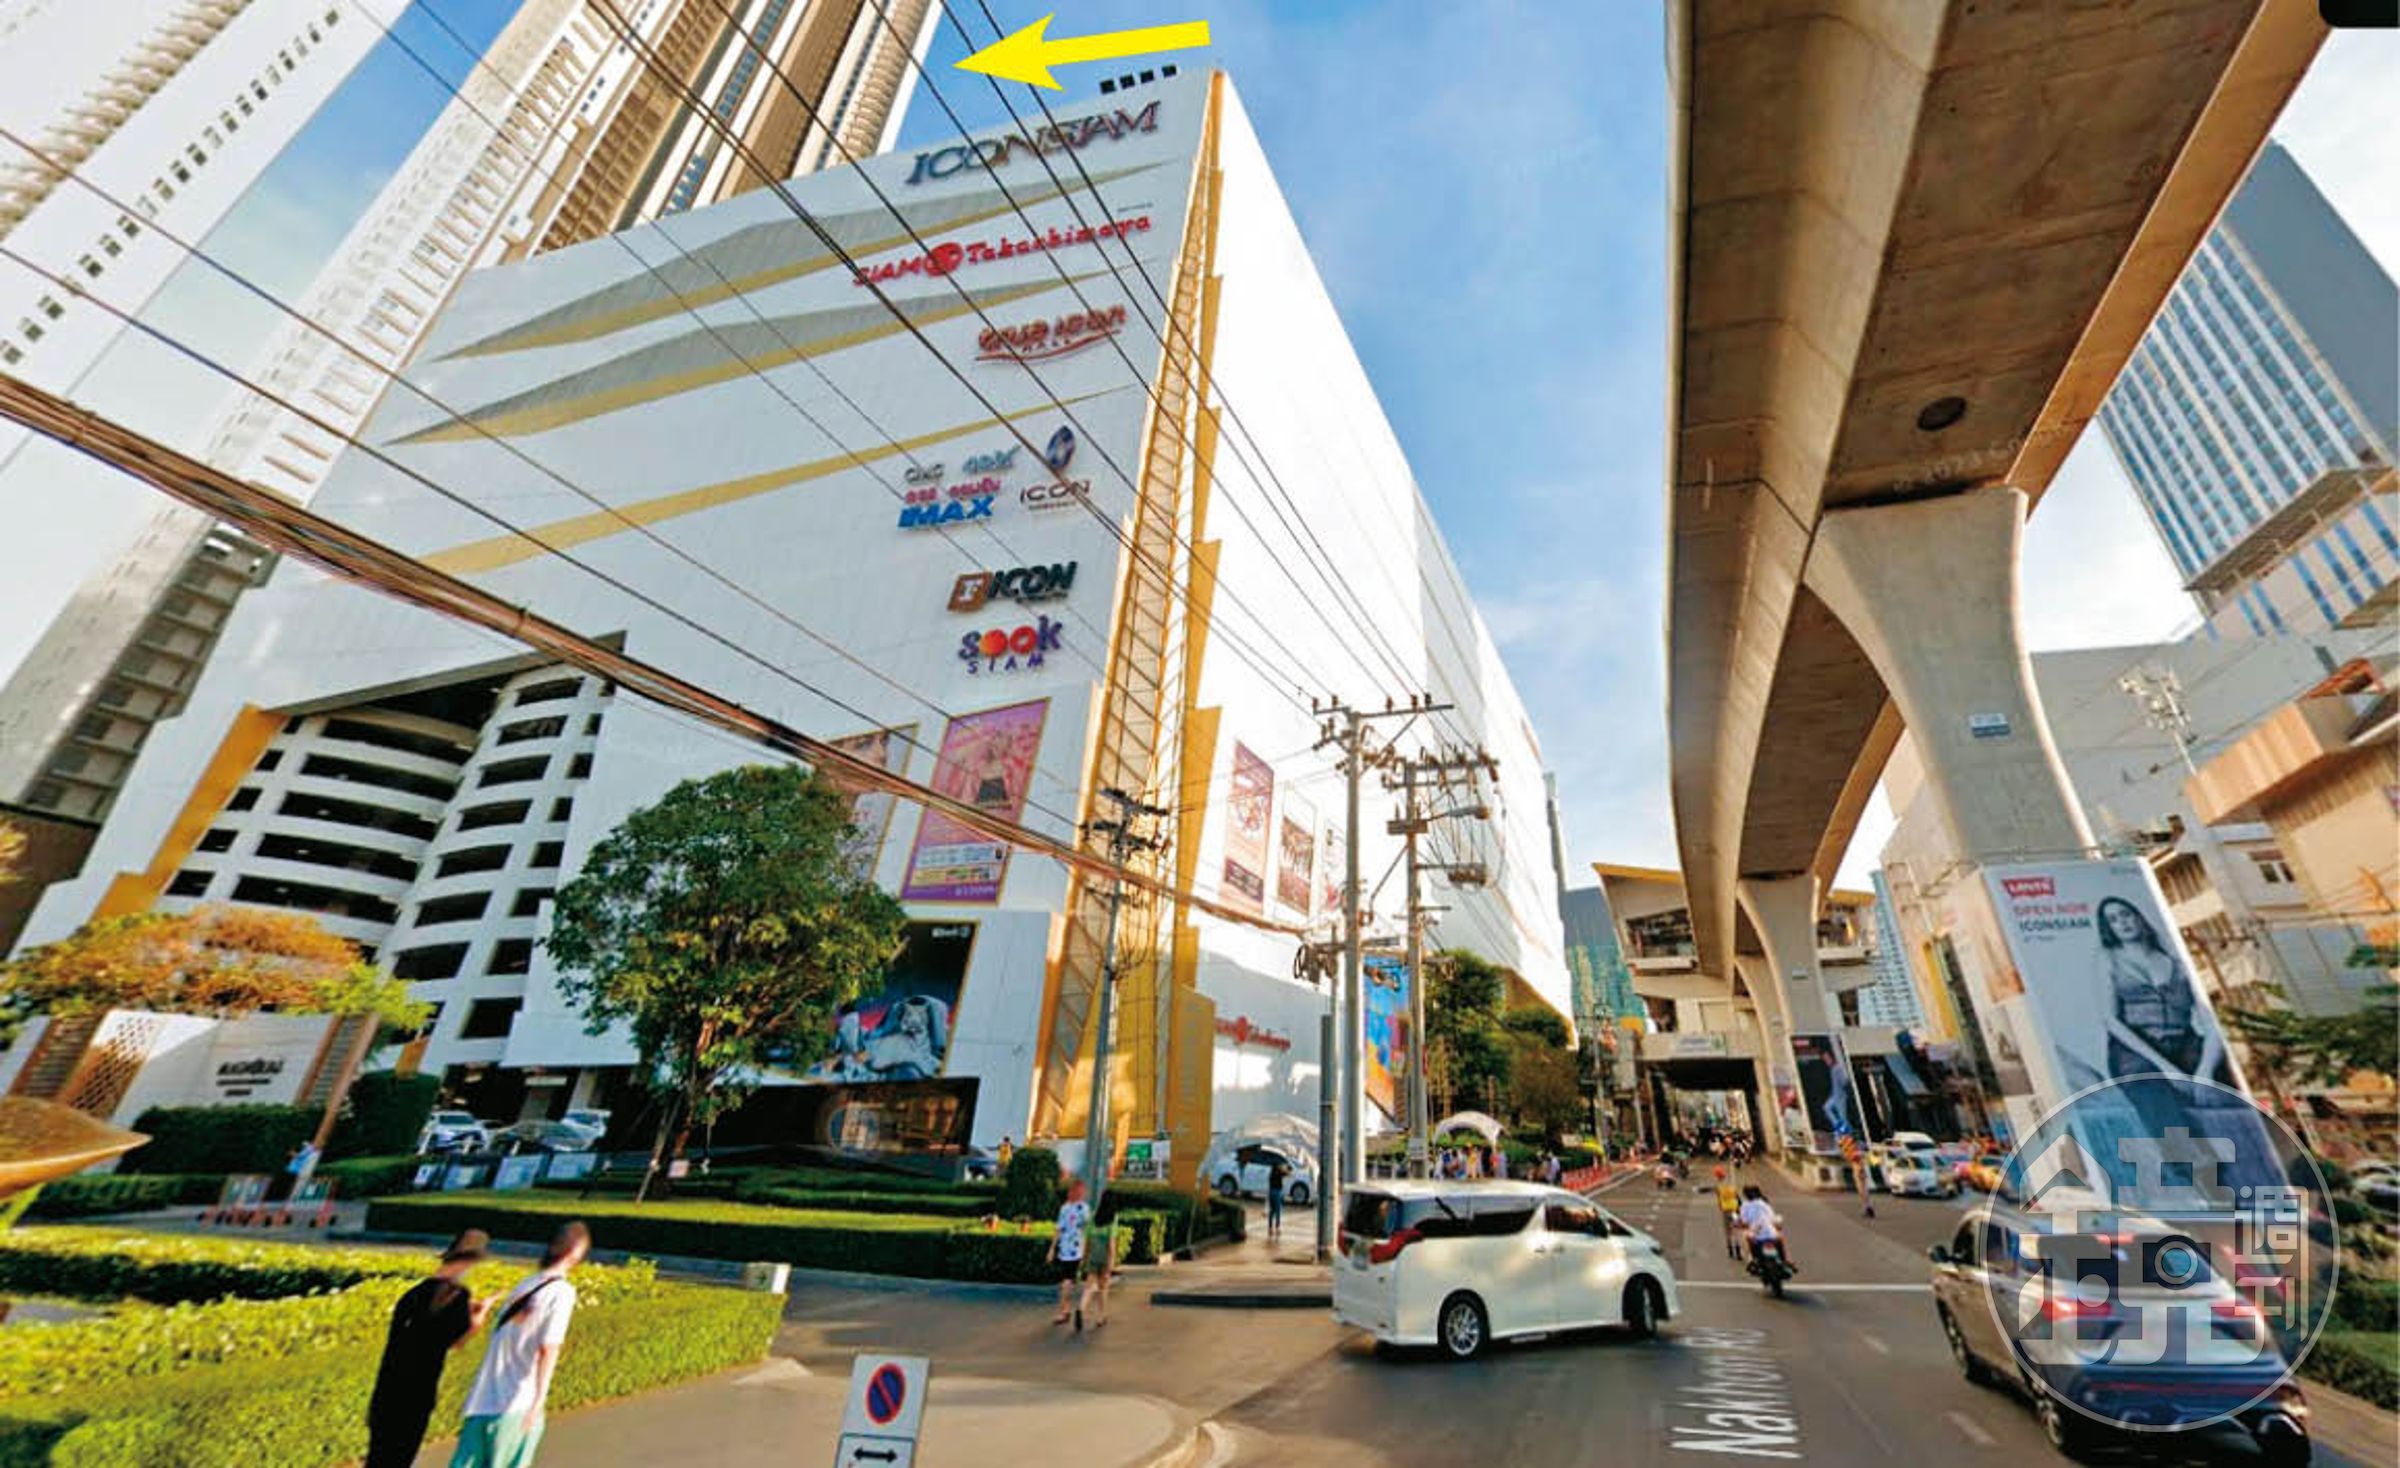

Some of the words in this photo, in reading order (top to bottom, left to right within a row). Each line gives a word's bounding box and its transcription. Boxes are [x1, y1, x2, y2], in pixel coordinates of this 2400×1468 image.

[905, 100, 1162, 185] ICONSIAM
[853, 255, 923, 287] SIAM
[1019, 479, 1091, 504] ICON
[898, 495, 995, 529] IMAX
[987, 560, 1079, 599] ICON
[967, 651, 1045, 675] SIAM
